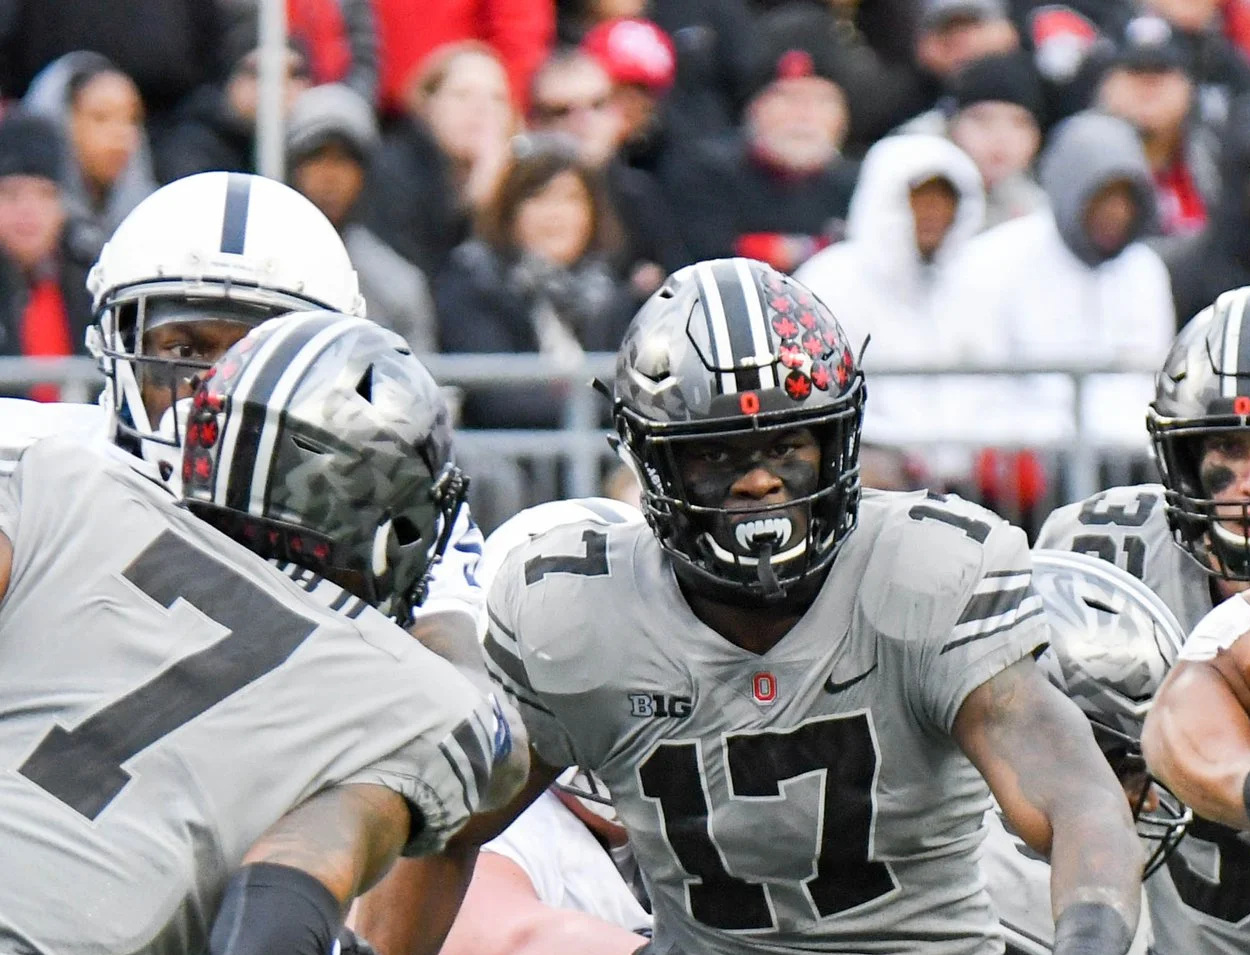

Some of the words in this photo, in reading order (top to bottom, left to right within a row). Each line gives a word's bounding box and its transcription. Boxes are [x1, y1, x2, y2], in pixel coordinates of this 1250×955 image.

[740, 391, 760, 415] O
[908, 490, 992, 545] 1
[523, 528, 611, 587] 7
[17, 527, 320, 823] 7
[753, 671, 777, 703] O
[636, 708, 902, 934] 17
